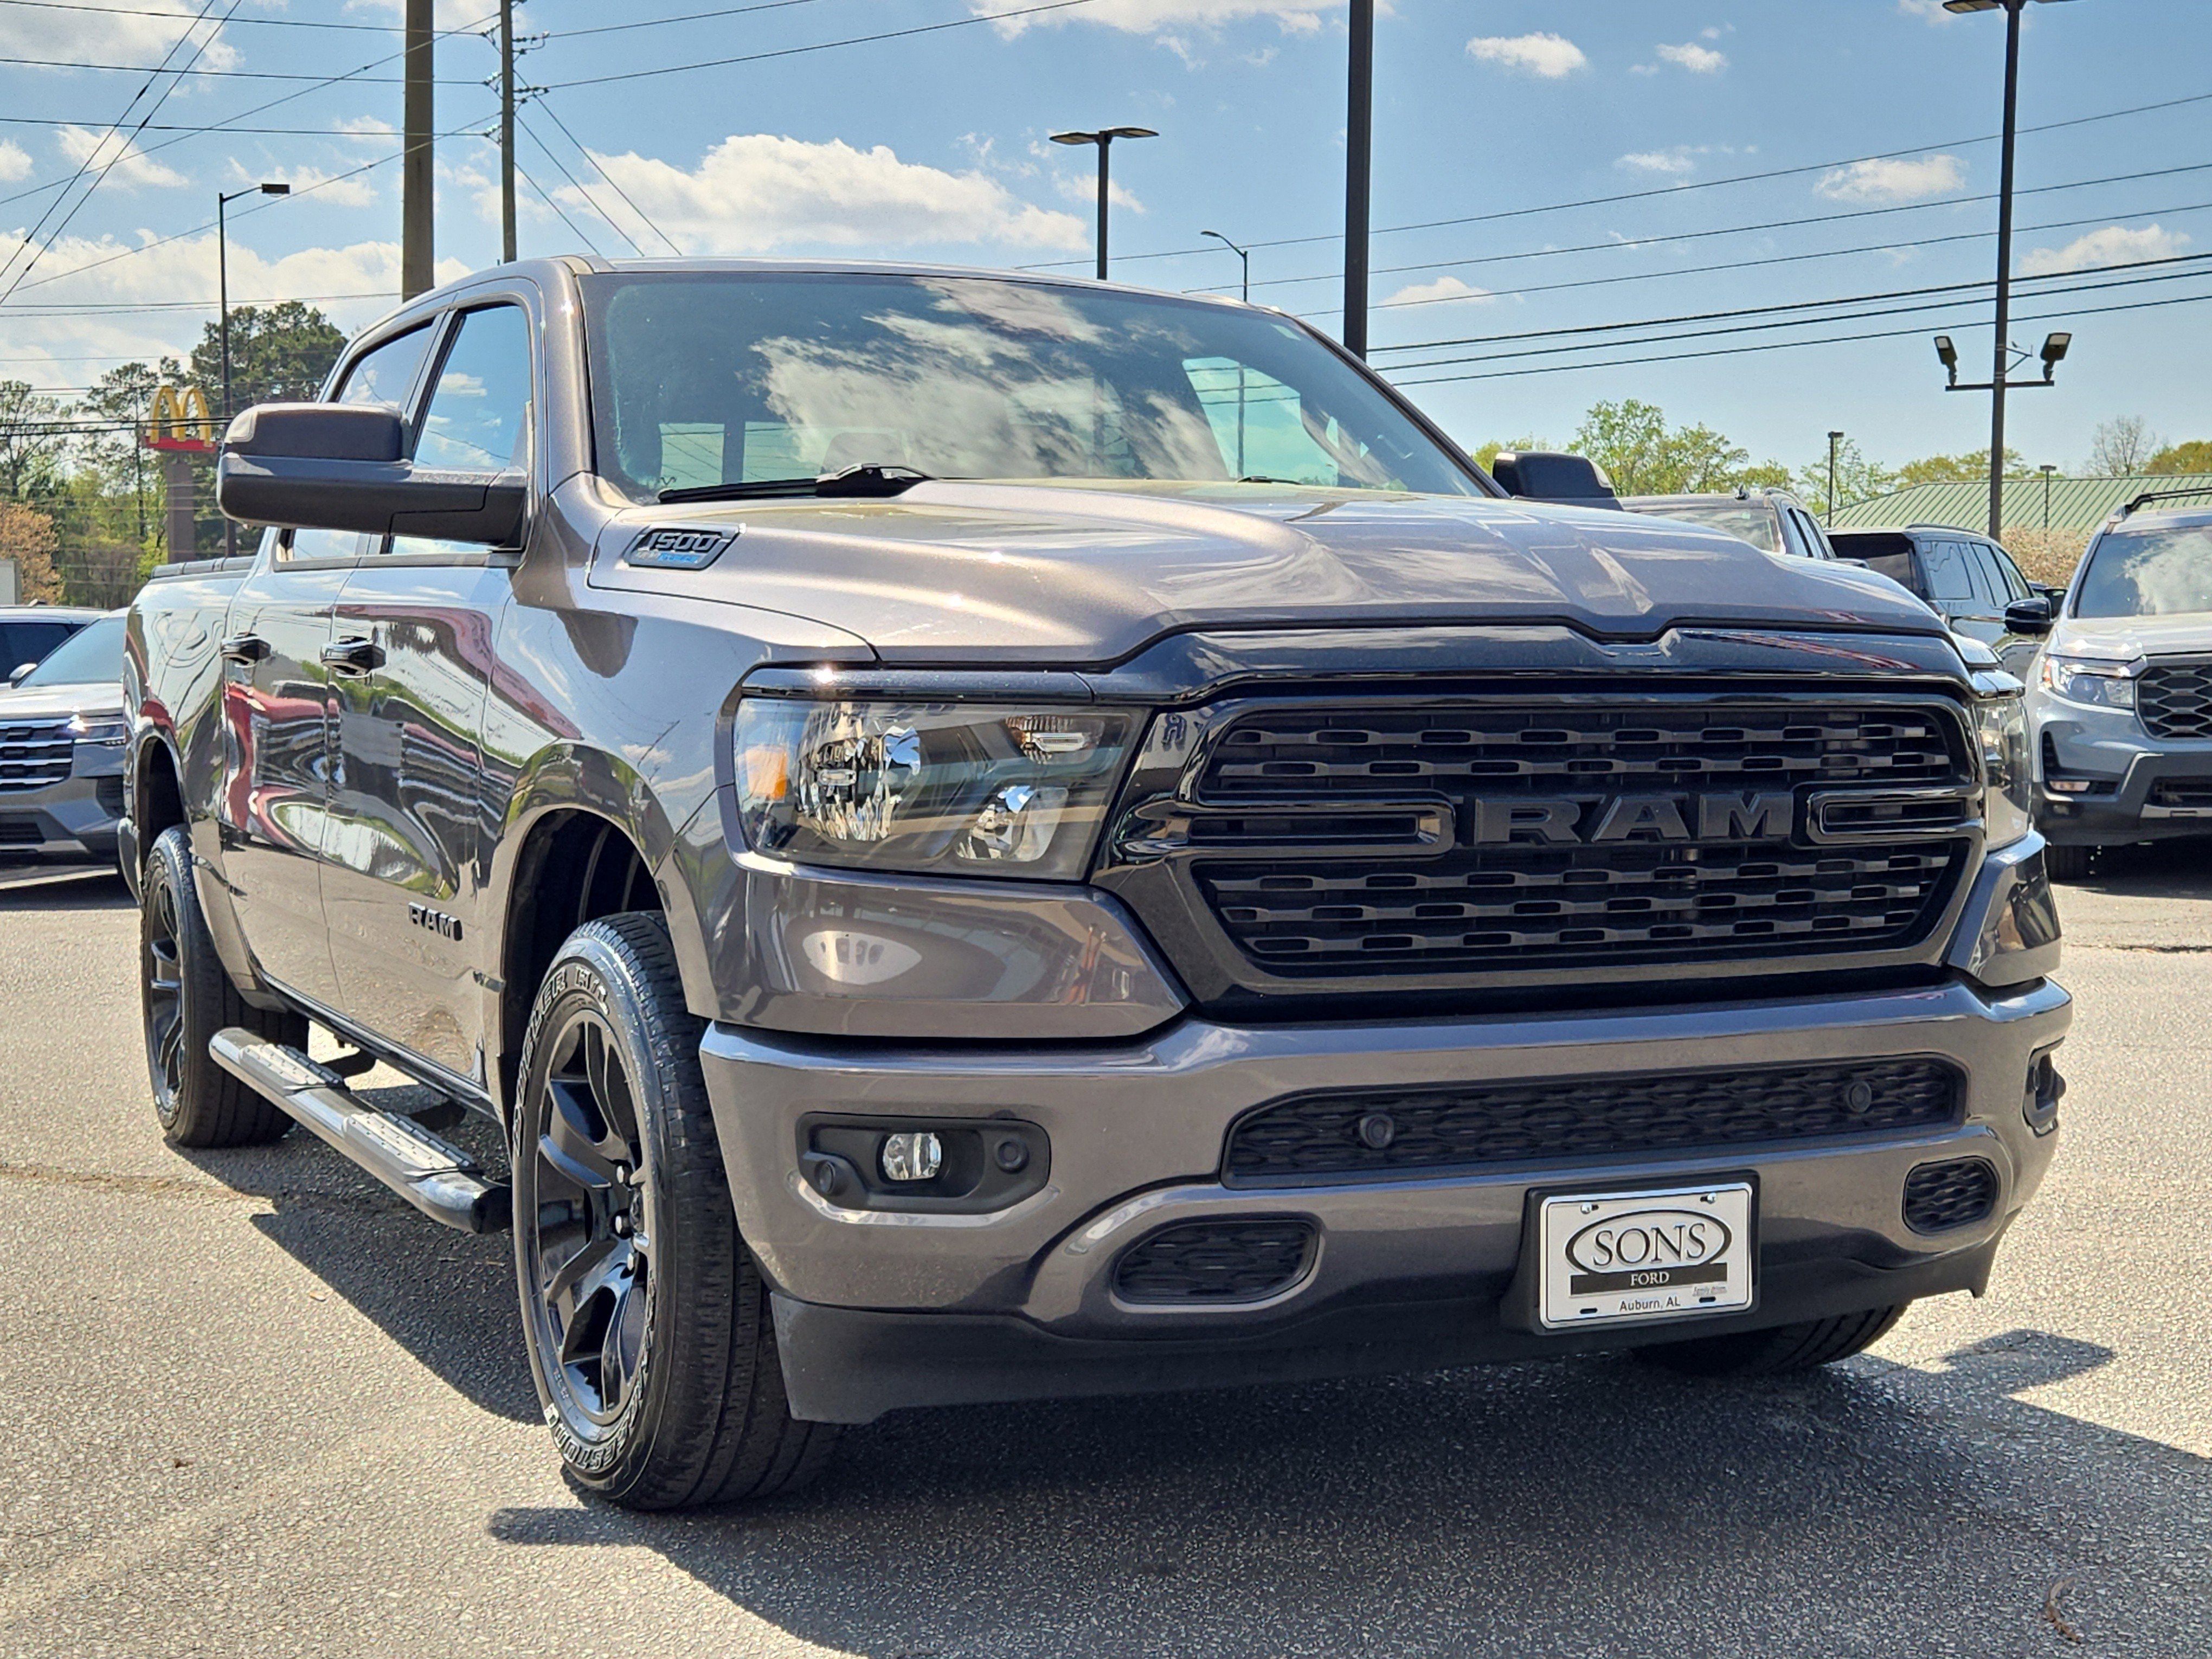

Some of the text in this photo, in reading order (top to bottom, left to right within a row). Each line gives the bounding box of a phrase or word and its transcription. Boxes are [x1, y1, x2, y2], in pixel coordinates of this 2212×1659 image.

[648, 532, 717, 550] 1500
[1474, 792, 1792, 843] RAM
[408, 902, 462, 941] RAM
[1592, 1223, 1706, 1266] SONS
[1630, 1271, 1669, 1286] FORD
[1619, 1296, 1681, 1311] Auburn, AL
